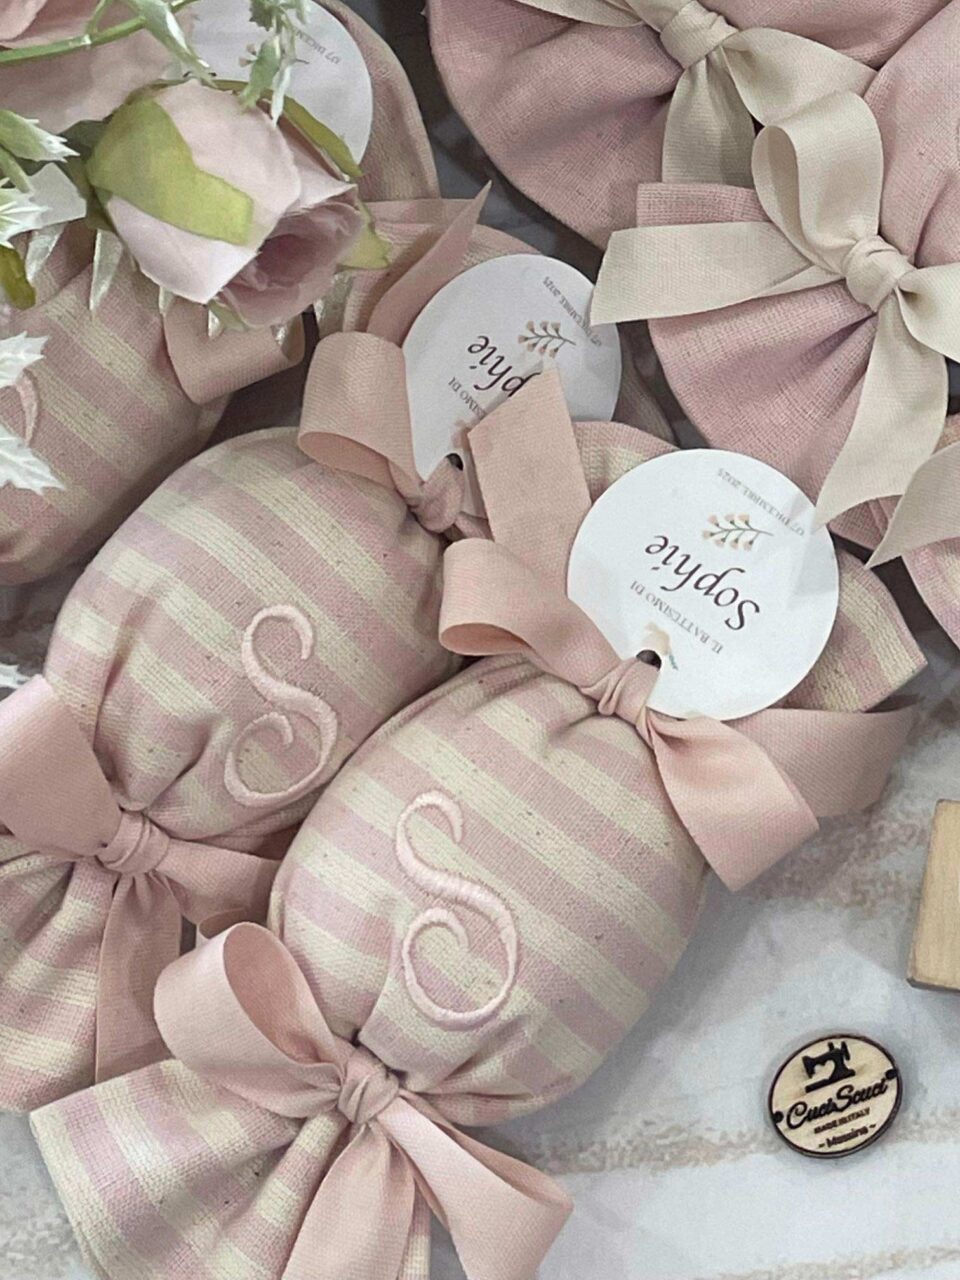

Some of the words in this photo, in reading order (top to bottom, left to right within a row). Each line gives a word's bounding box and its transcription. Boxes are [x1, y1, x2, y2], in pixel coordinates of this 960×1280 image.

[467, 335, 540, 398] phie
[630, 581, 645, 597] DI
[644, 535, 760, 631] Sophie
[645, 592, 710, 642] BATTESIMO
[224, 604, 337, 806] S
[396, 790, 517, 1029] S
